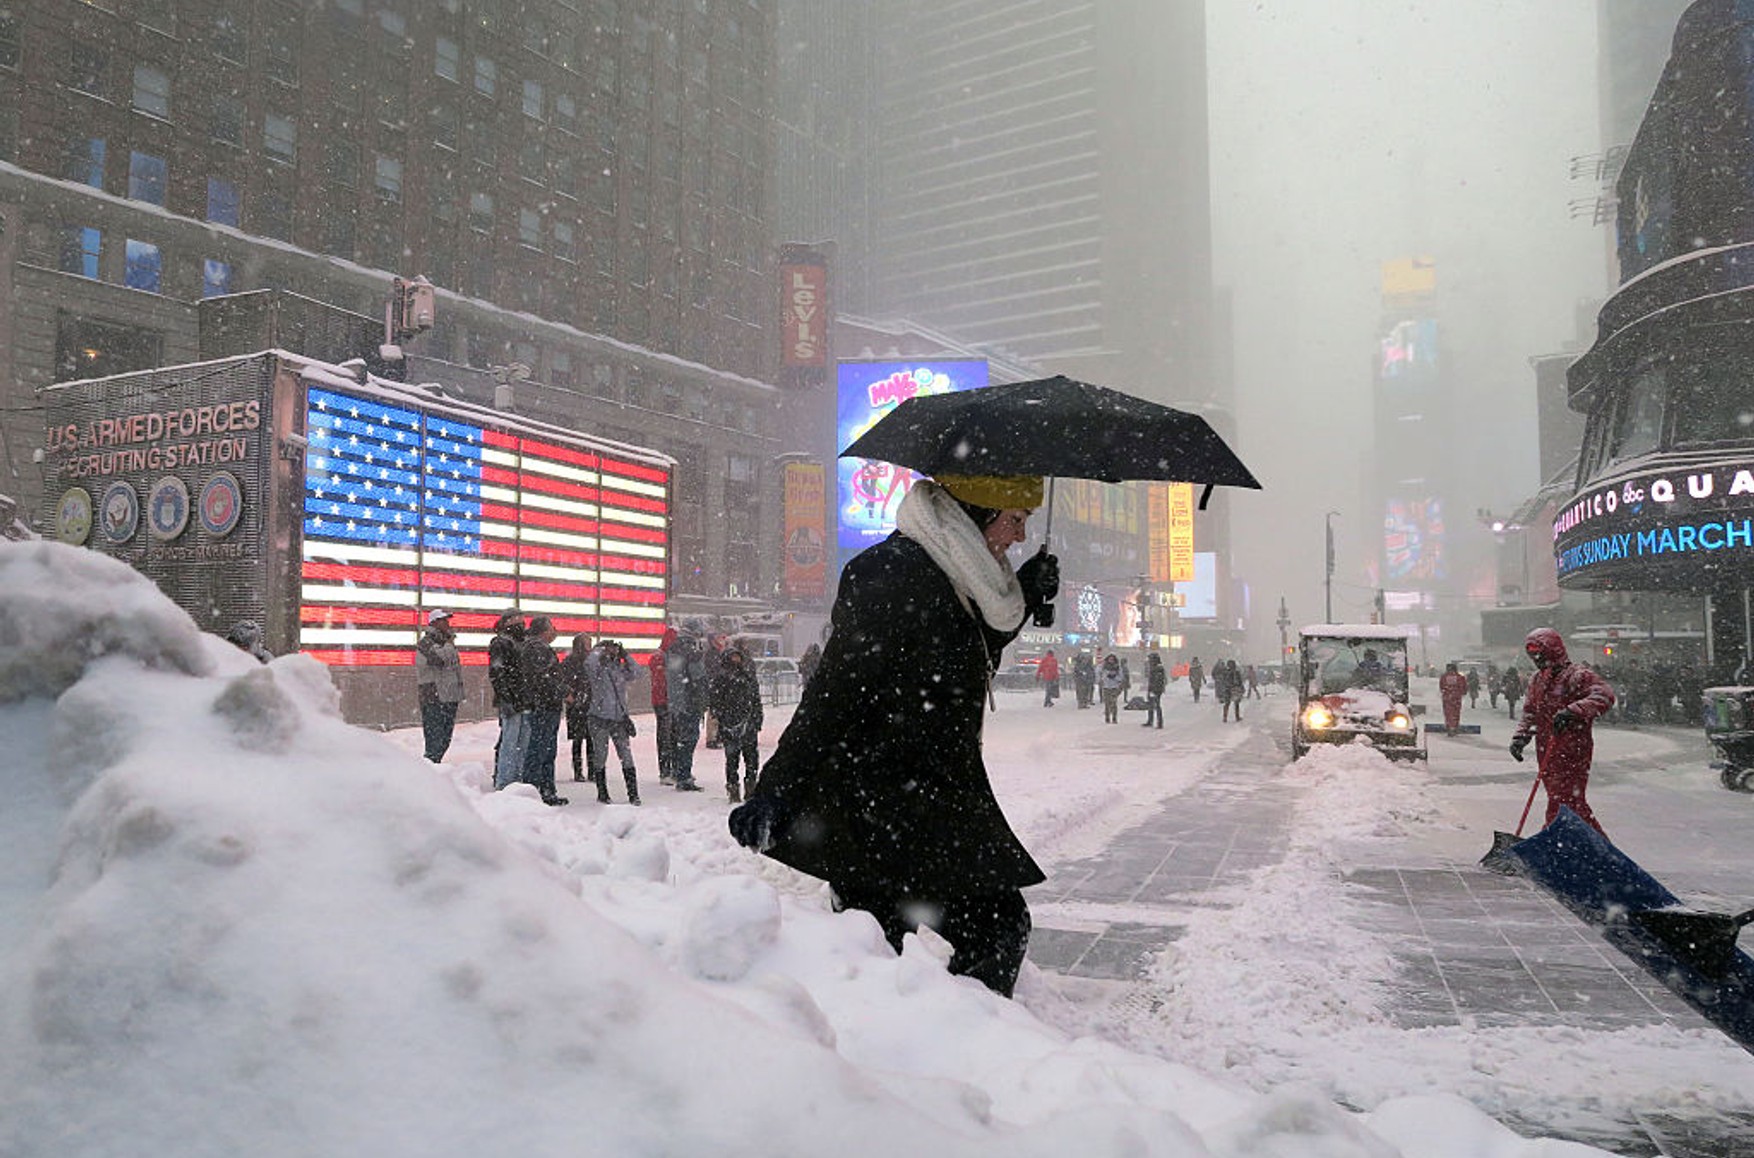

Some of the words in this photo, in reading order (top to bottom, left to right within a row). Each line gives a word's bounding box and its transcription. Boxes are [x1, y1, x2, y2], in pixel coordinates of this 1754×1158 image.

[83, 413, 164, 448] ARMED
[165, 400, 261, 439] FORCES
[164, 438, 246, 469] STATION
[1553, 487, 1618, 541] ANTICO
[1582, 533, 1632, 565] SUNDAY
[1637, 519, 1753, 556] MARCH
